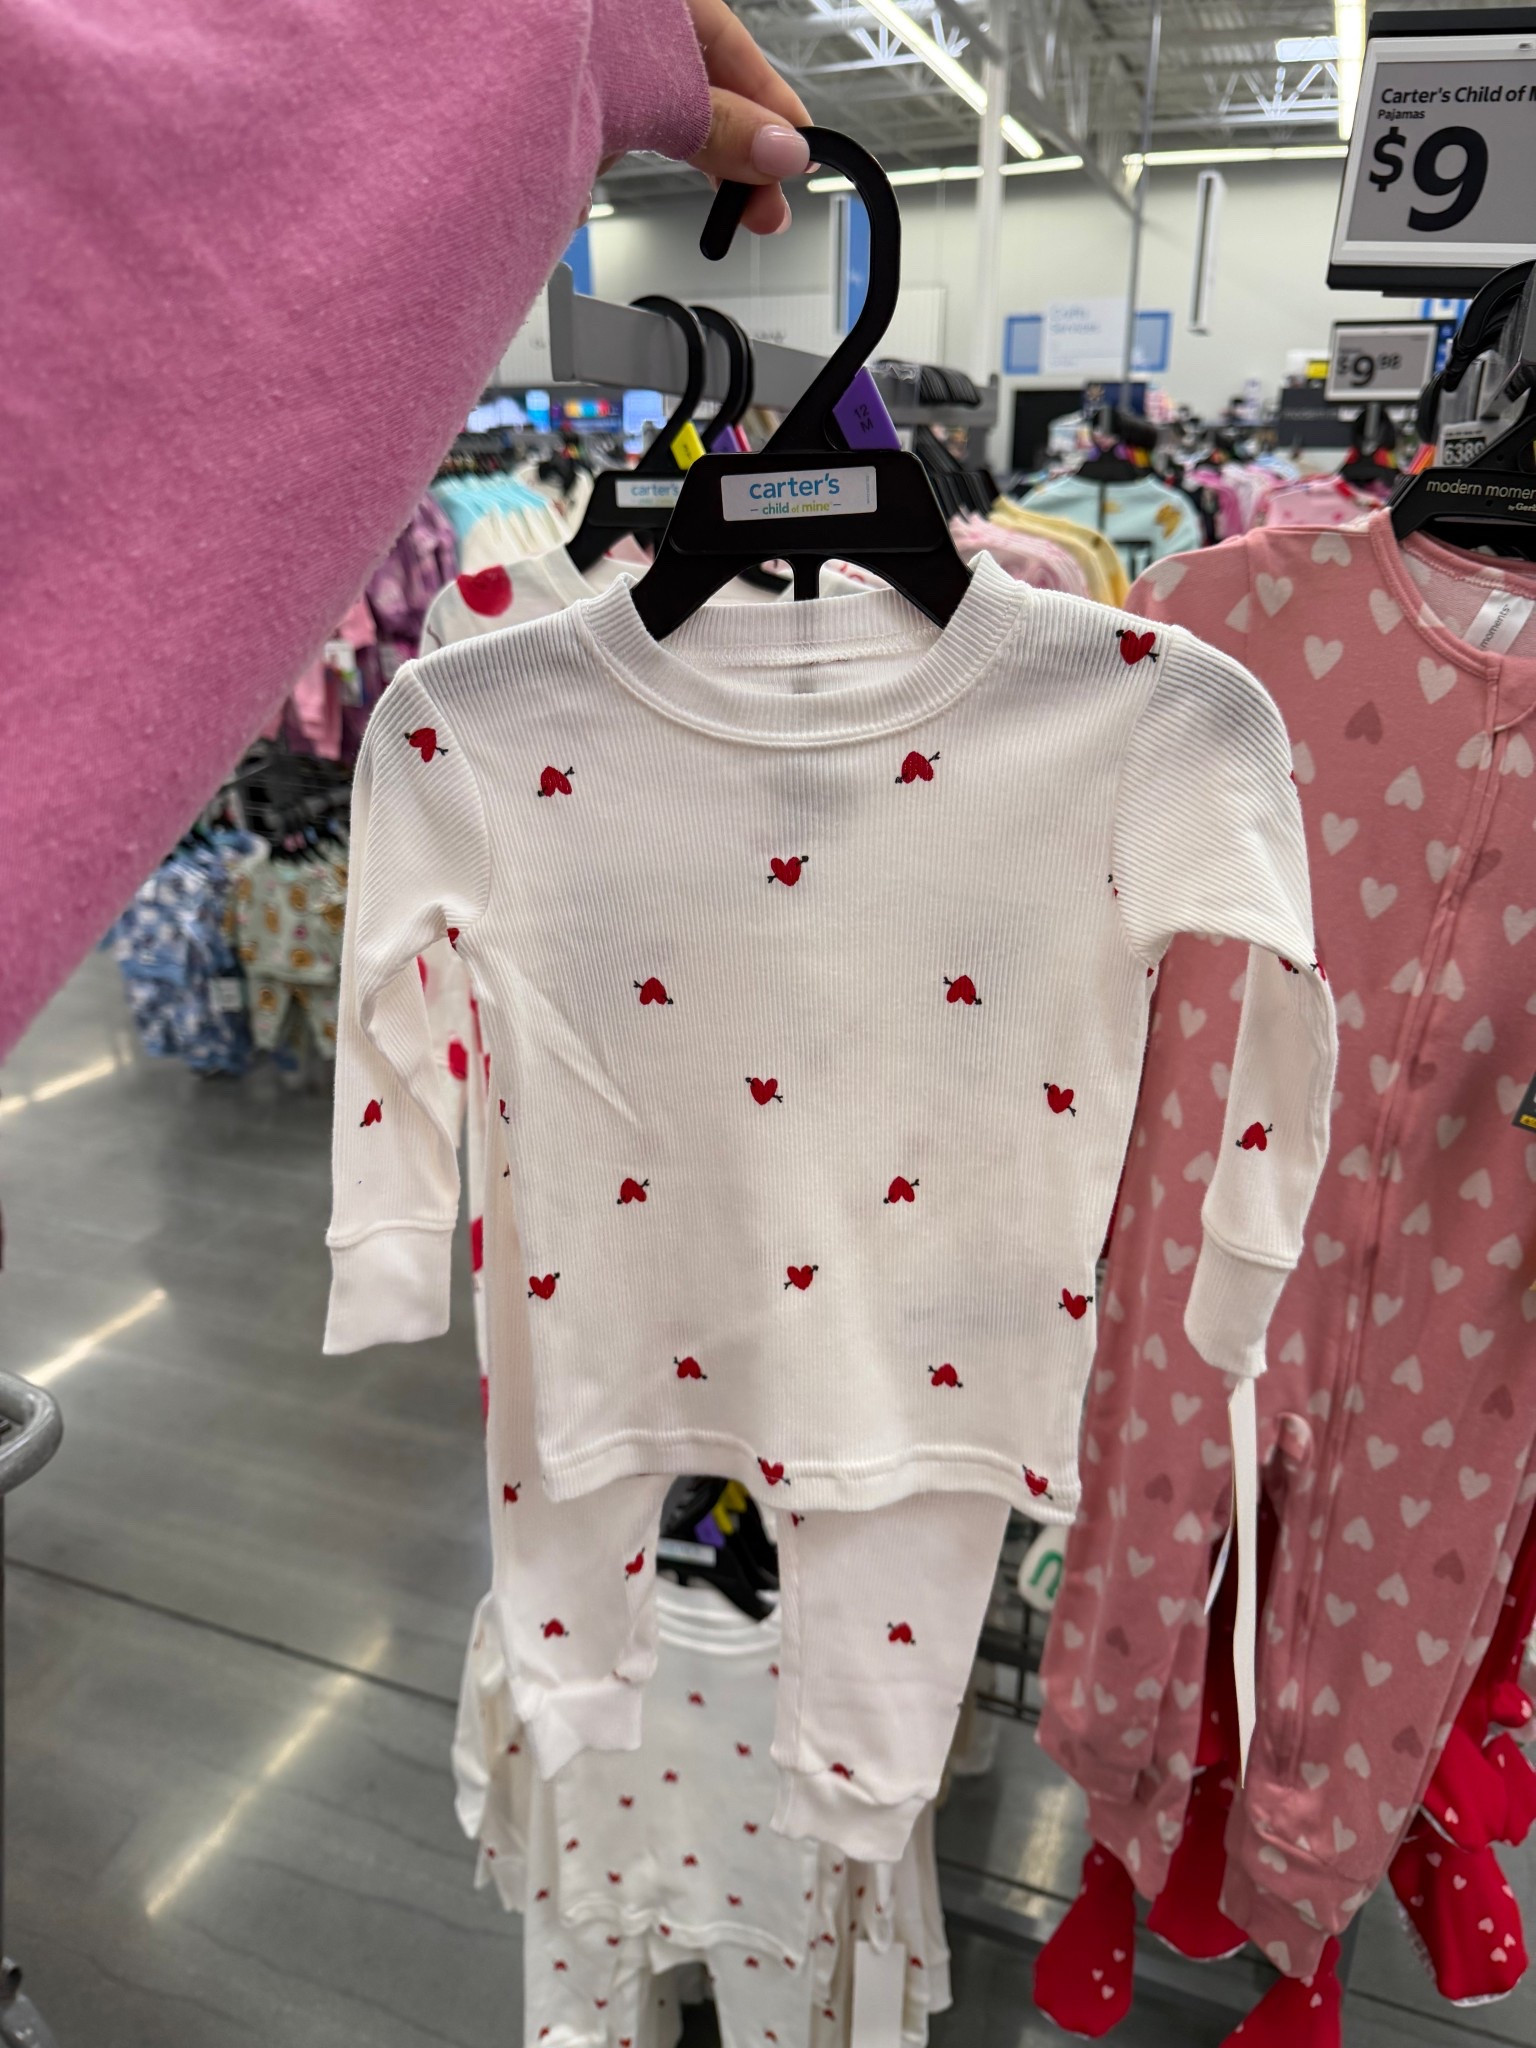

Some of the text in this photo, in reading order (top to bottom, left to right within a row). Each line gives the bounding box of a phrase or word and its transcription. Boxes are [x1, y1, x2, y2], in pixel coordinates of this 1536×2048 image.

[1381, 87, 1451, 104] Carter's
[1455, 86, 1503, 103] Child
[1505, 85, 1527, 102] of
[1377, 109, 1426, 121] Pajamas
[1368, 126, 1488, 232] $9
[854, 403, 870, 420] 12
[860, 417, 874, 433] M
[631, 484, 678, 496] carter's
[750, 473, 840, 499] carter's
[1426, 478, 1482, 496] modern
[762, 500, 830, 515] child of mine
[1480, 603, 1511, 649] moments
